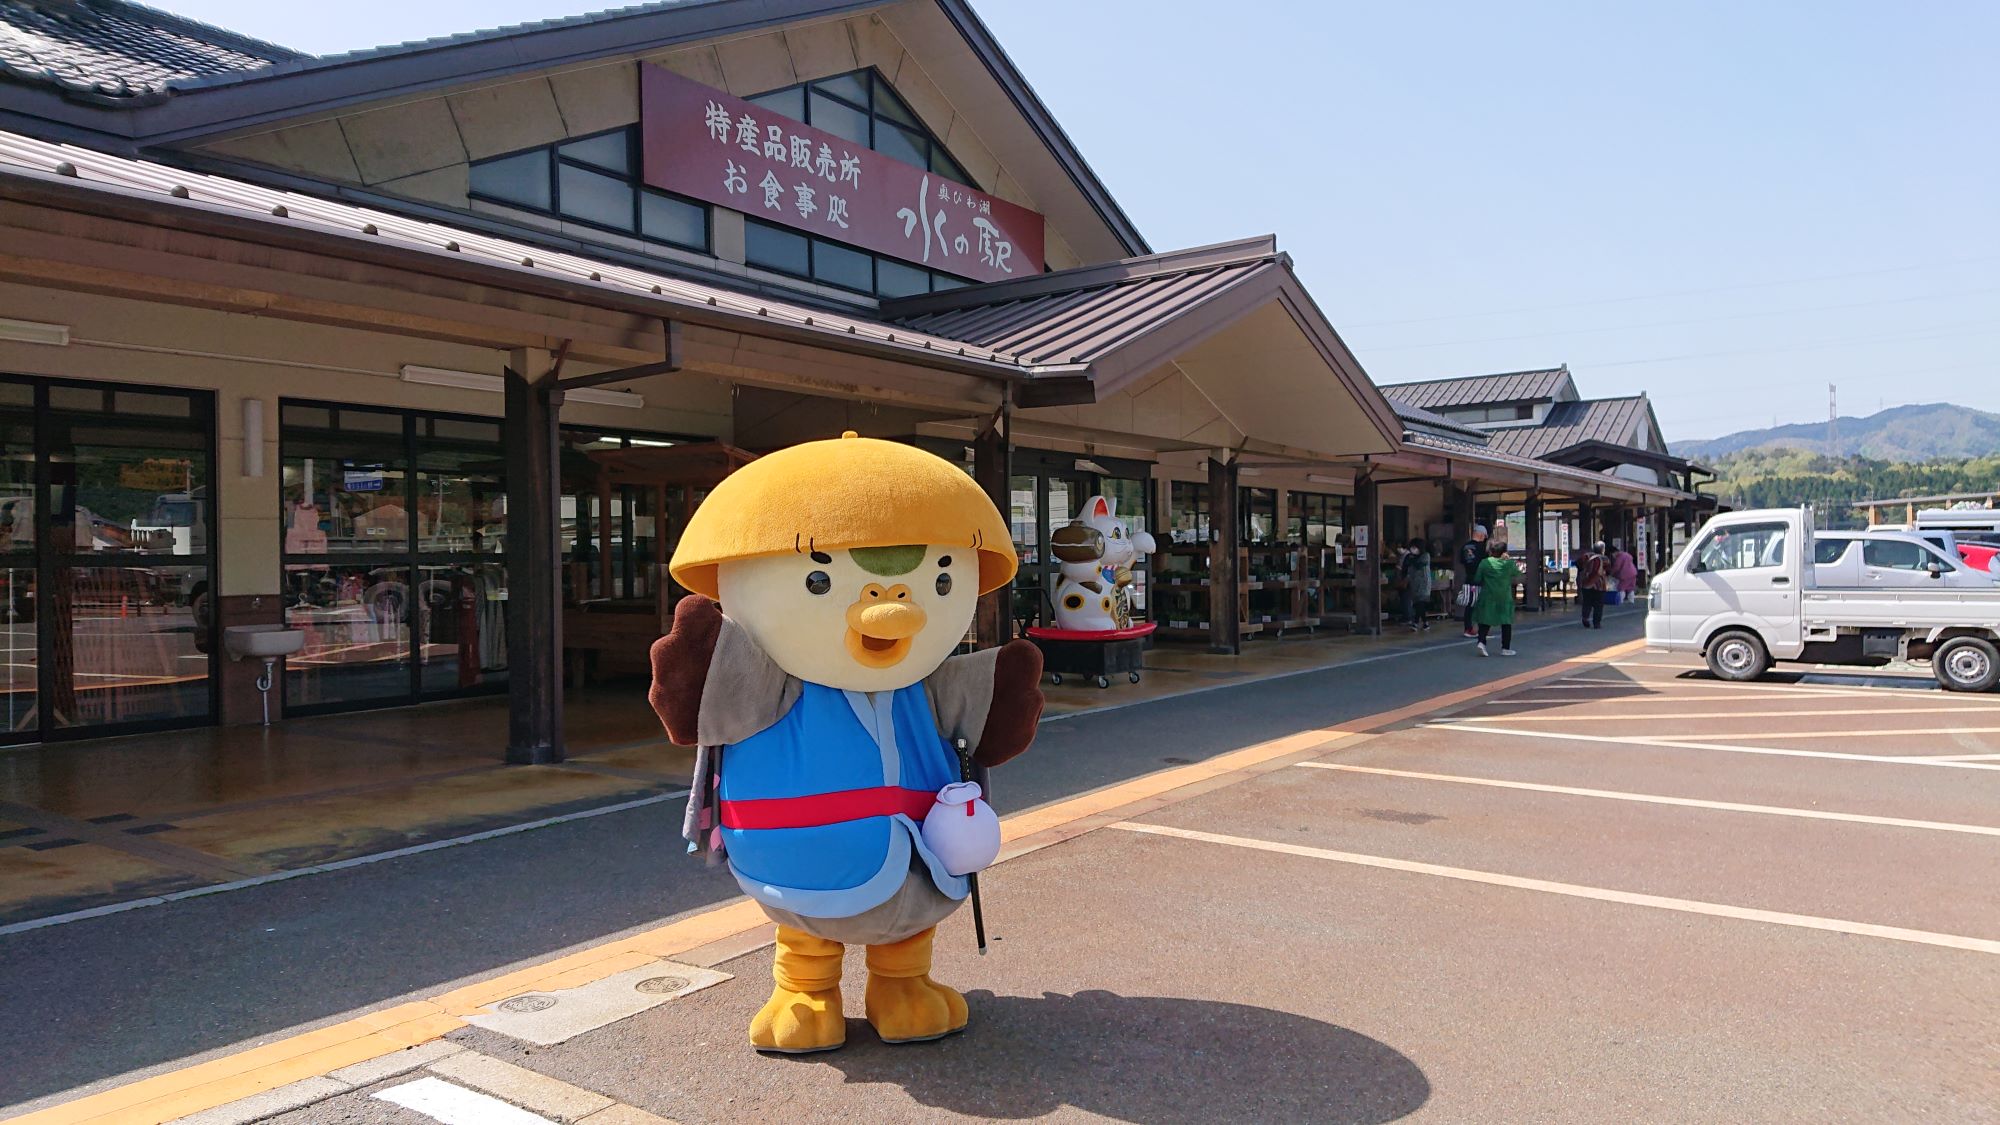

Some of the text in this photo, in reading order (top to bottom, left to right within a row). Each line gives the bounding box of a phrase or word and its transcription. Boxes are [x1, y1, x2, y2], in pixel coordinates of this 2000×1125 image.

[705, 100, 861, 190] 特産品販売所
[723, 160, 849, 228] お食事処
[897, 174, 1012, 273] 水の駅
[937, 183, 991, 216] 奥びわ湖
